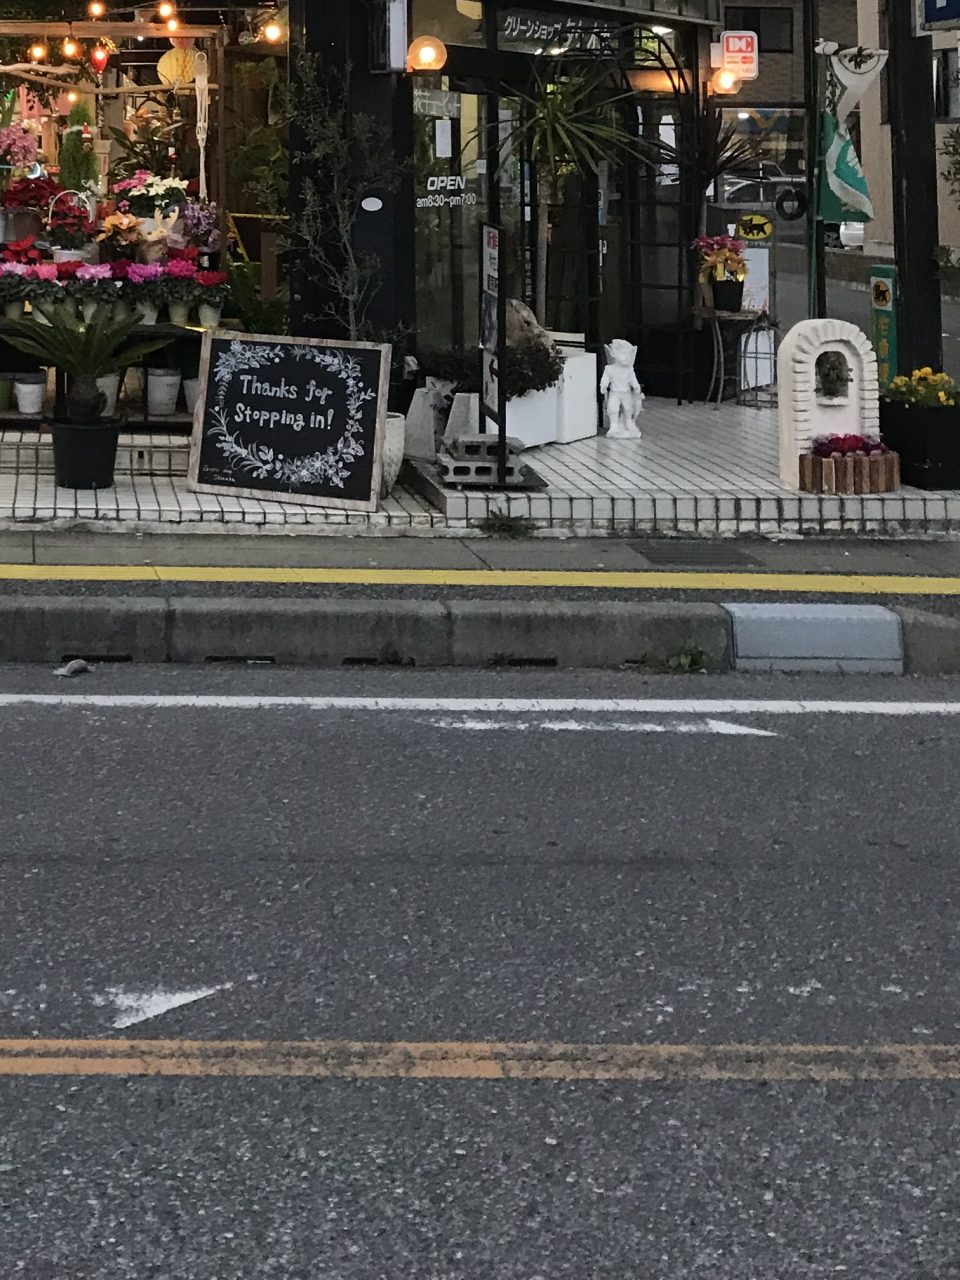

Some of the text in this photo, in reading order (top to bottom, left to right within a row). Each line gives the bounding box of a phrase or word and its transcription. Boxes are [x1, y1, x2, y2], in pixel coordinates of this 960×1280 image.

[504, 15, 563, 41] グリーンショップ
[728, 37, 752, 51] DC
[427, 176, 466, 191] OPEN
[239, 374, 333, 405] Thanks for
[234, 402, 335, 431] Stopping in!
